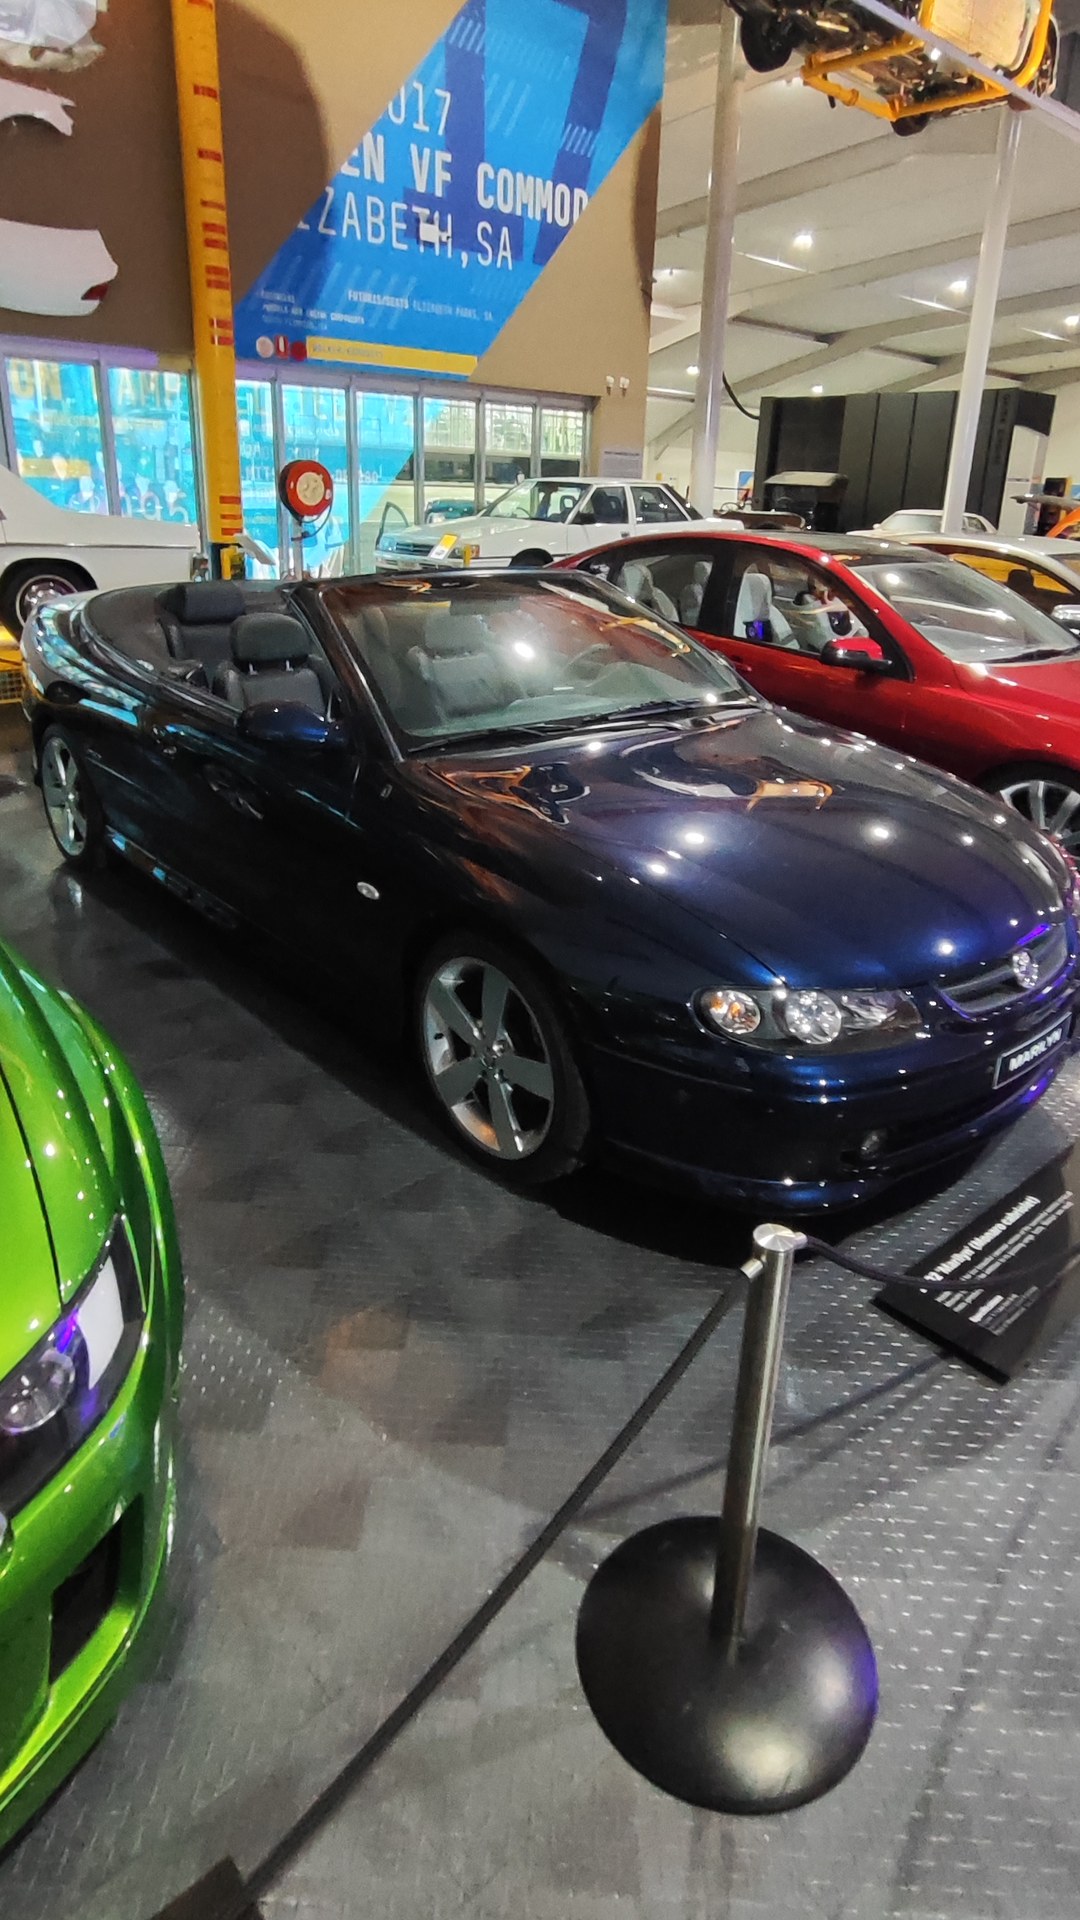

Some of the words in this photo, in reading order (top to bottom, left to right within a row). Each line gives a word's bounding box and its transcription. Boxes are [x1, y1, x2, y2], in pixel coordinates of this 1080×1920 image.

[379, 82, 451, 136] 017
[410, 143, 453, 197] VF
[477, 162, 590, 227] COMMOD
[298, 186, 513, 271] ZABETH,SA
[1009, 1027, 1062, 1071] MARILYN
